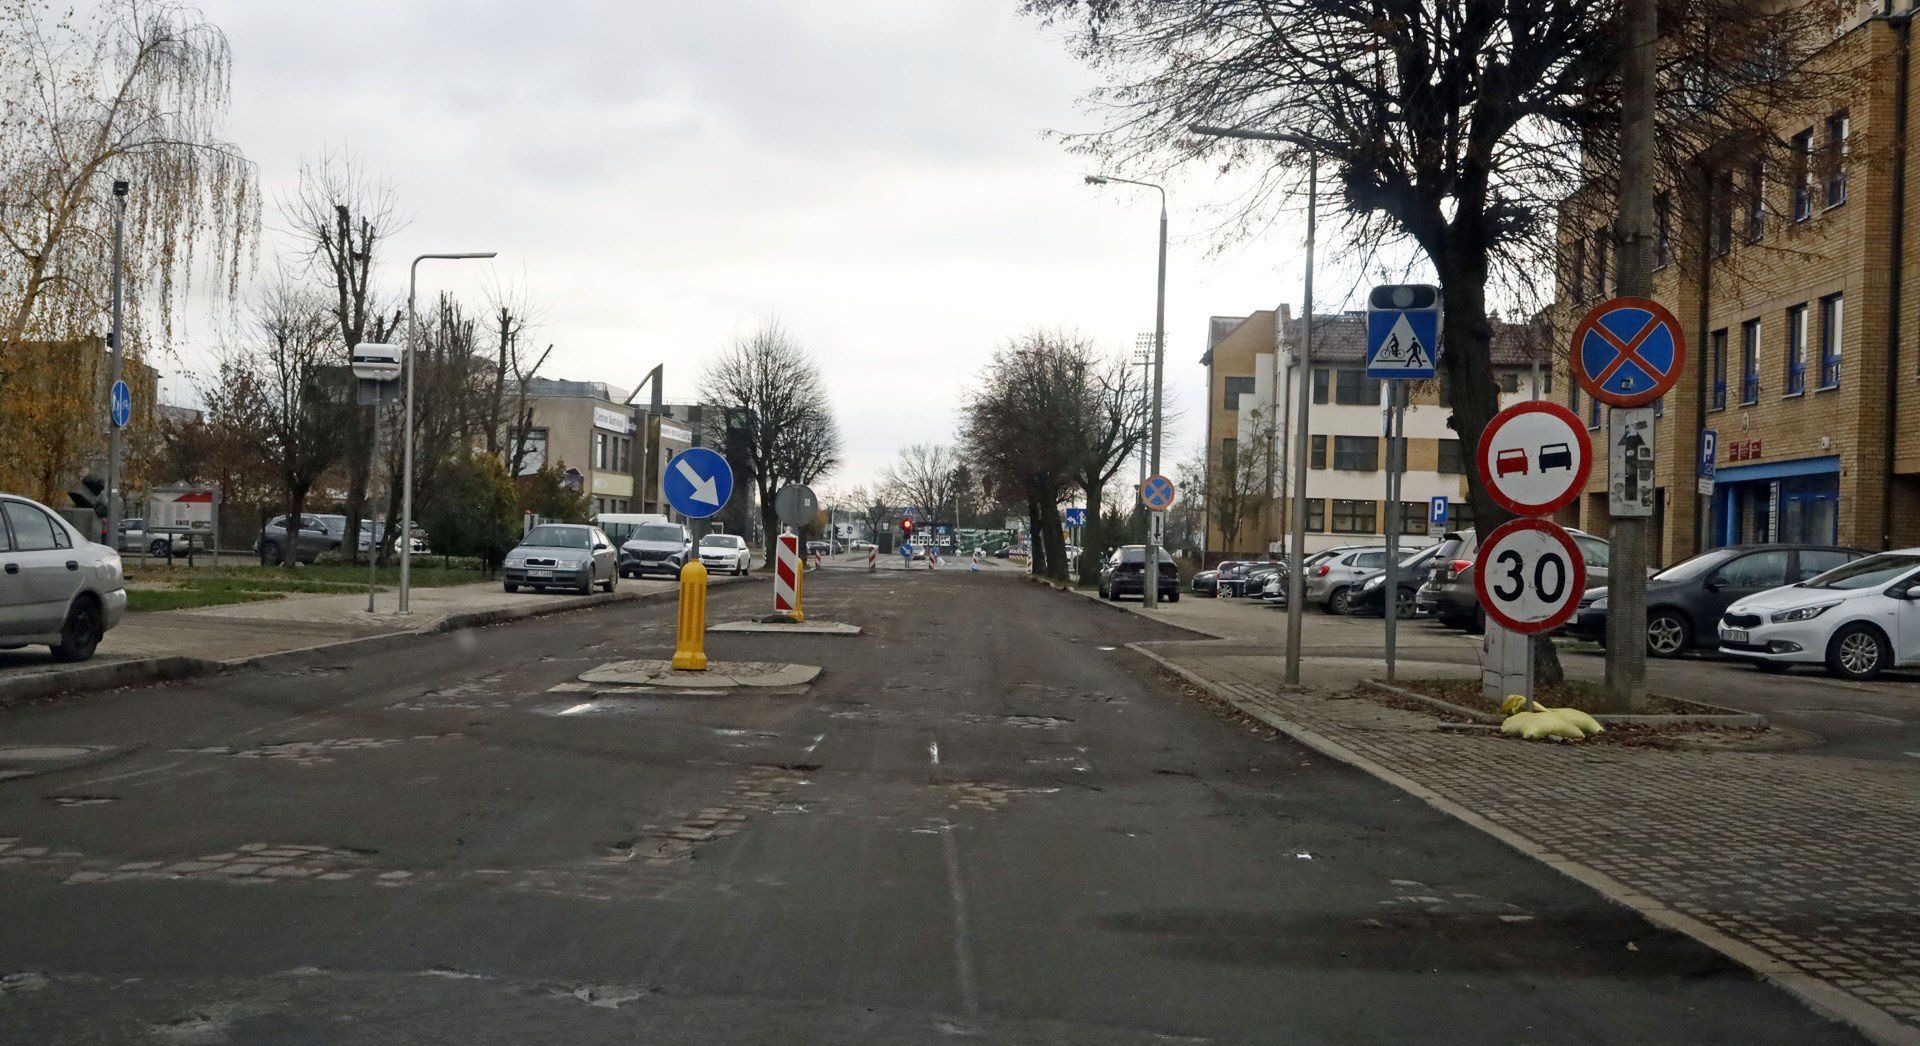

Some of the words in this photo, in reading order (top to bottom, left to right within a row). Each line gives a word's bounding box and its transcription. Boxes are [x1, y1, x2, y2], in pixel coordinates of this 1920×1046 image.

[1703, 434, 1714, 463] P
[1434, 499, 1444, 520] P
[1494, 549, 1566, 604] 30
